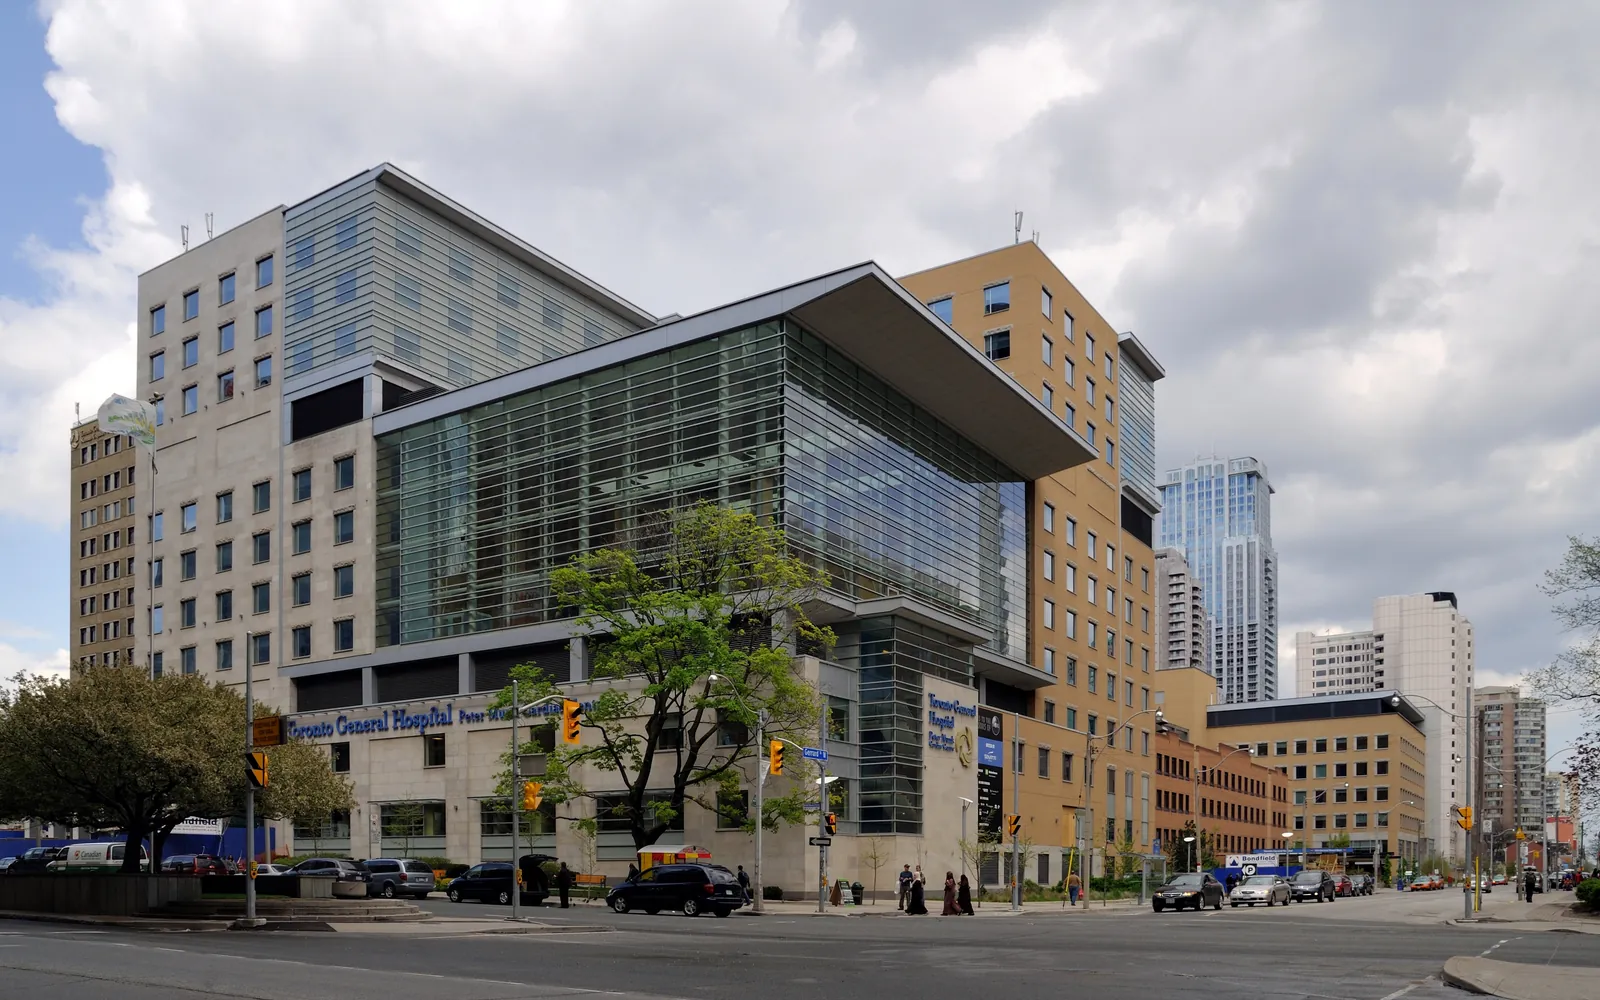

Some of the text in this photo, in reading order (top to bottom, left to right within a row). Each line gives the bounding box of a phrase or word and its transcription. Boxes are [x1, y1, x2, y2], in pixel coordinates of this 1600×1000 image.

[287, 720, 333, 738] Toronto
[336, 710, 389, 736] General
[392, 703, 453, 735] Hospital
[459, 710, 484, 724] Peter
